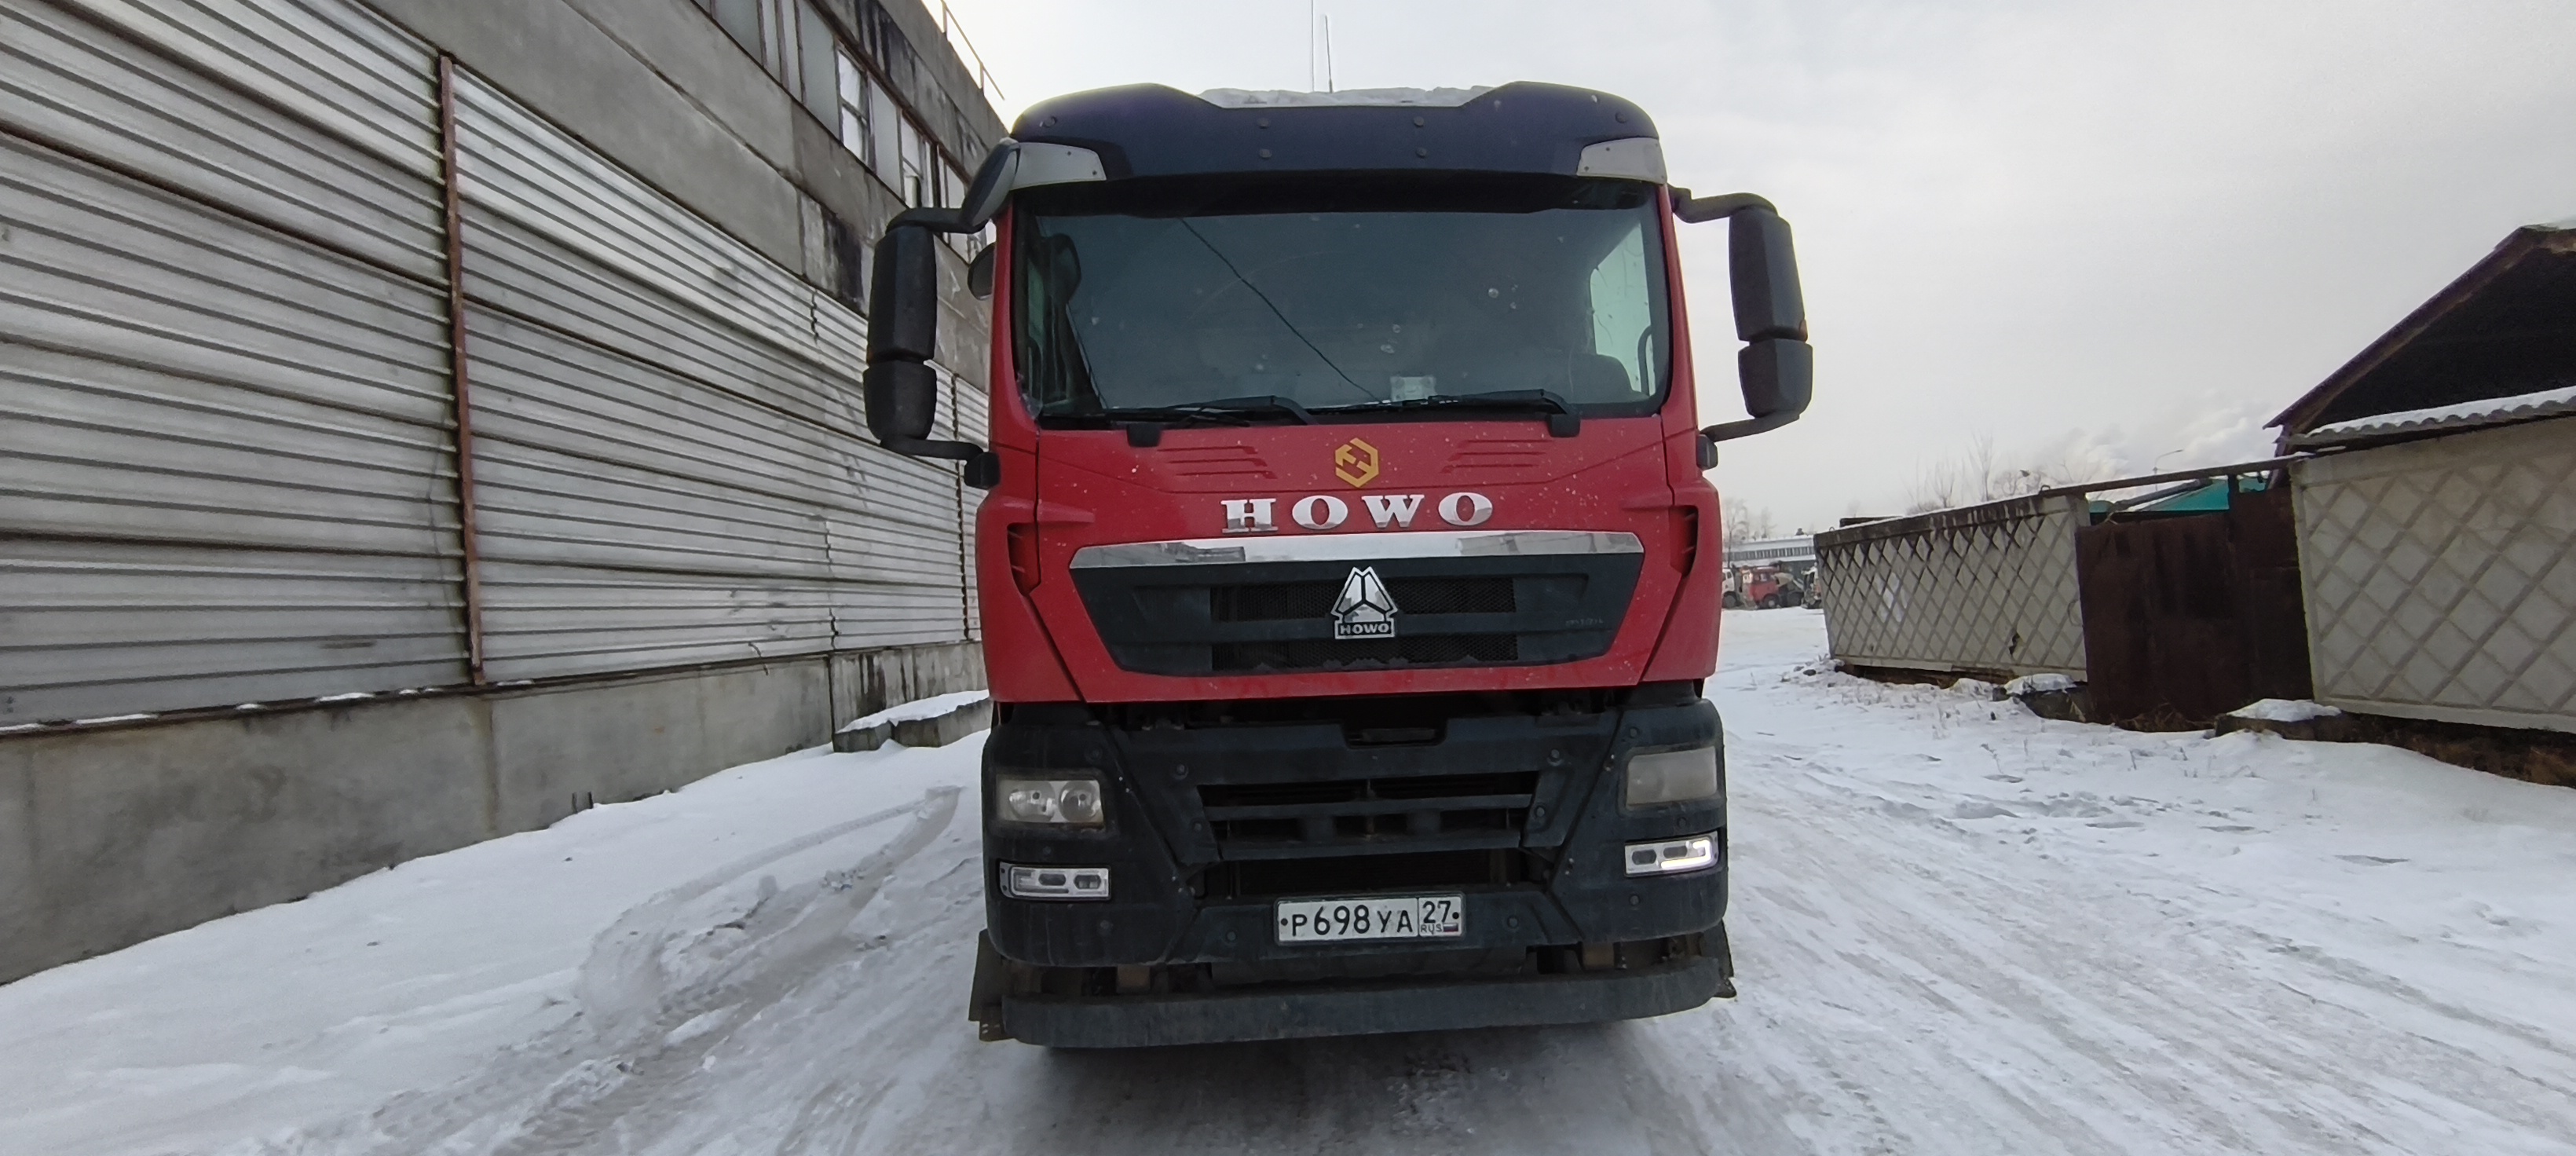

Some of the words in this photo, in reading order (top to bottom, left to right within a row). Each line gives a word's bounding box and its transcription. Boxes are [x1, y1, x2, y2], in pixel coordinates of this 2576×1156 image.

[1220, 492, 1493, 533] HOWO
[1340, 623, 1389, 635] HOWO
[1422, 900, 1451, 924] 27
[1421, 924, 1443, 935] RUS
